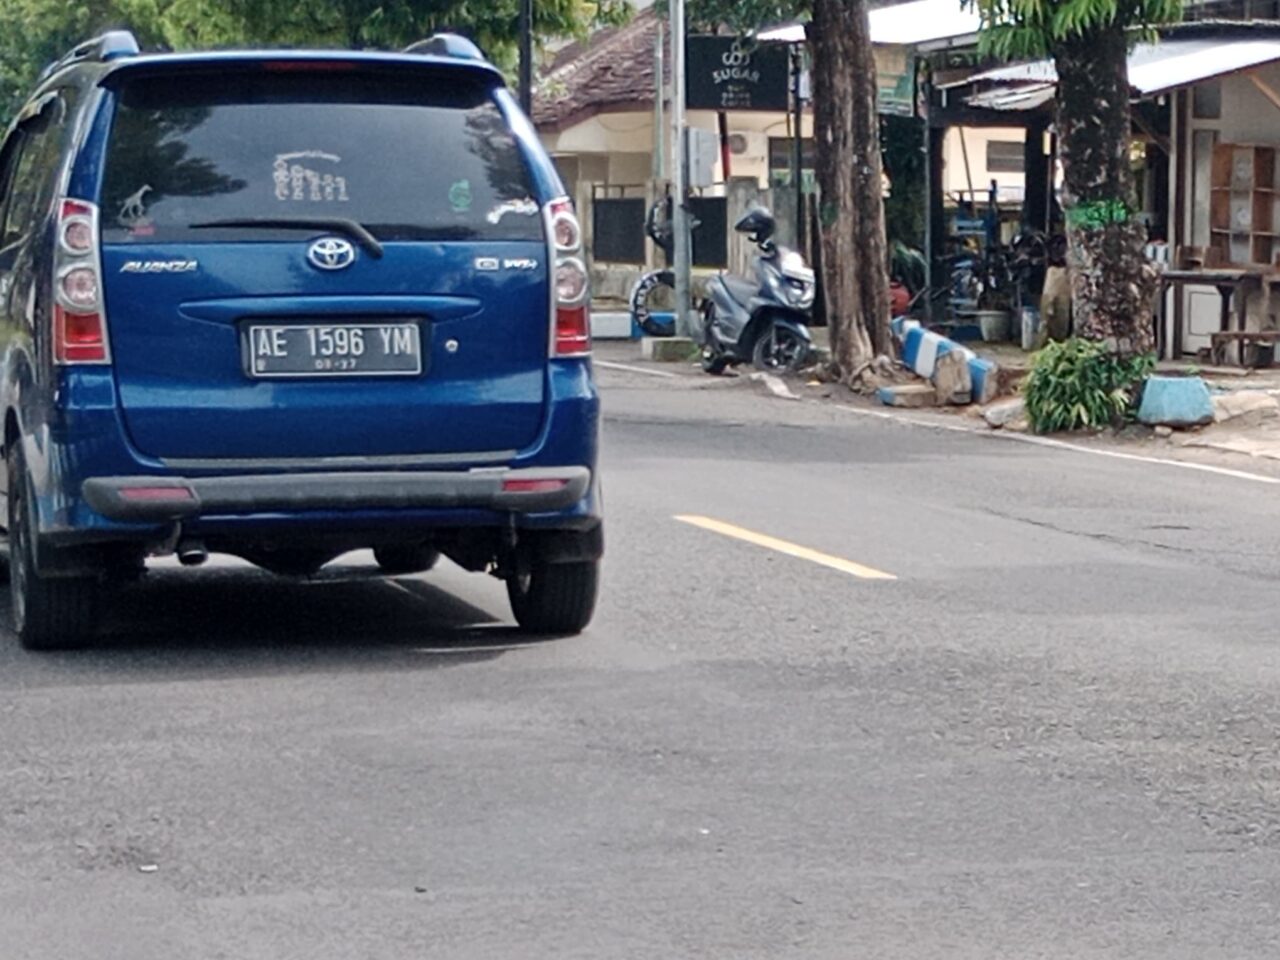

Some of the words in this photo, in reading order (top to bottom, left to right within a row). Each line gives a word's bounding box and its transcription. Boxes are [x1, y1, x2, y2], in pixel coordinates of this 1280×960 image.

[712, 67, 759, 84] SUGAR
[257, 329, 288, 356] AE
[306, 328, 364, 356] 1596
[379, 327, 411, 355] YM
